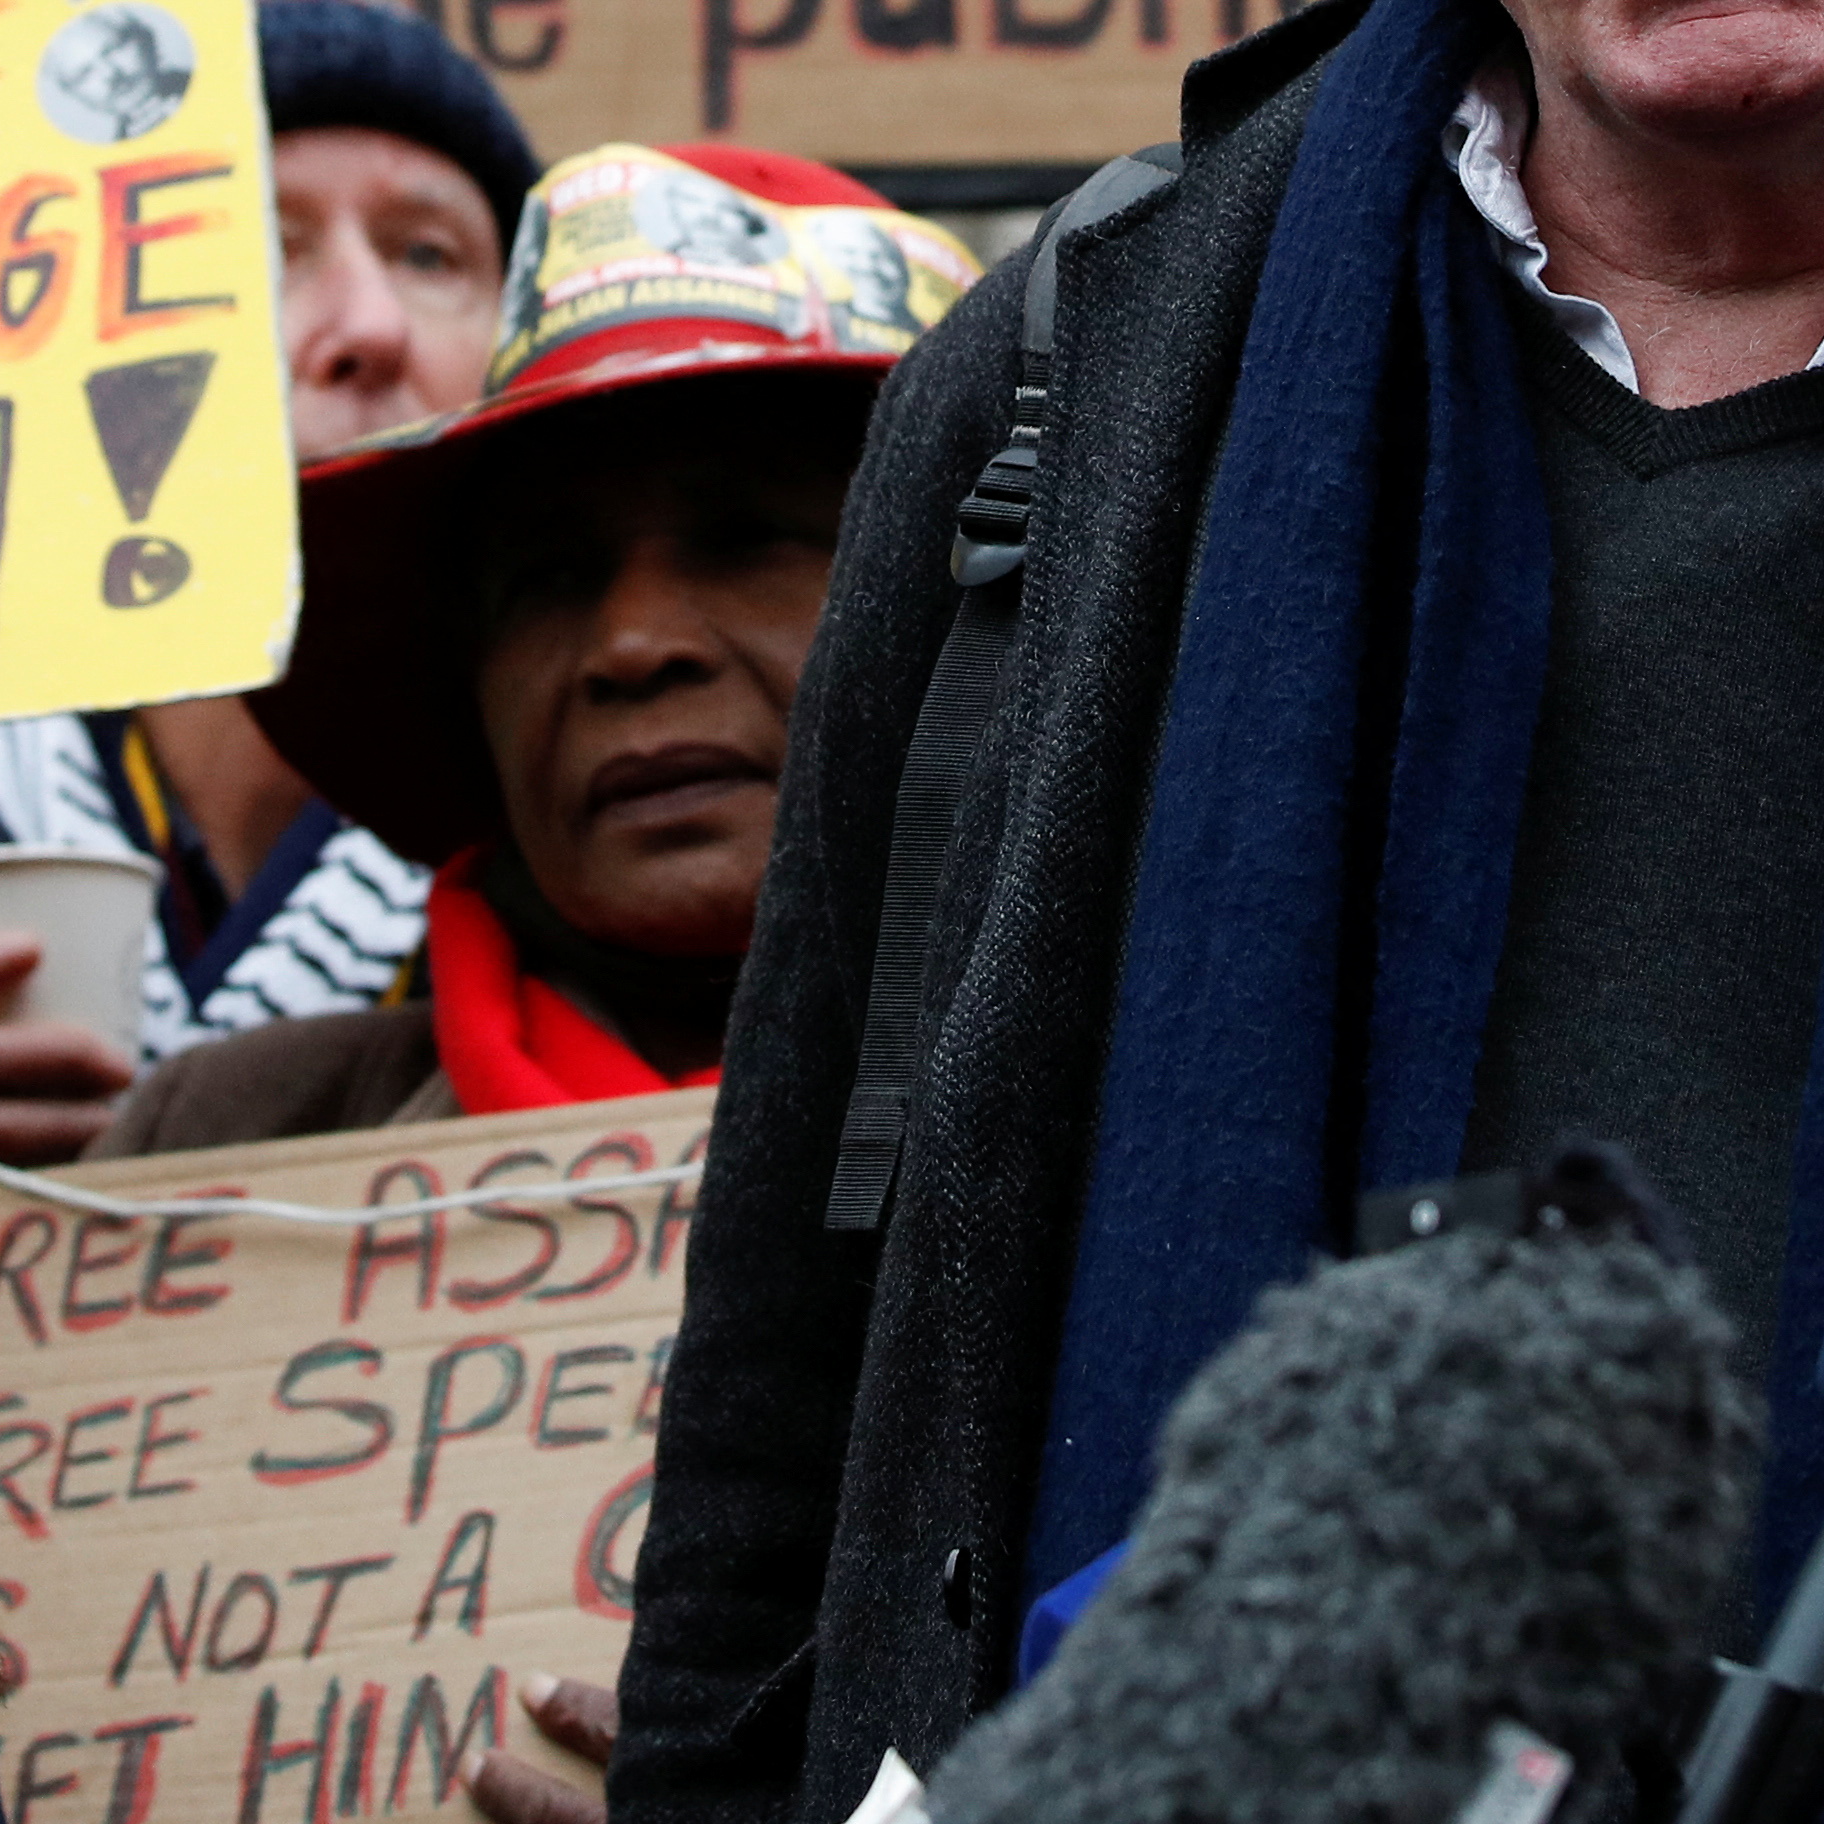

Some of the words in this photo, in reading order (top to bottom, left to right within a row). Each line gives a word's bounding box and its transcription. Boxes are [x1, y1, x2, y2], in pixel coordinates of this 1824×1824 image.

[108, 1554, 397, 1687] NOT
[413, 1509, 495, 1640] A
[237, 1667, 506, 1824] HIM
